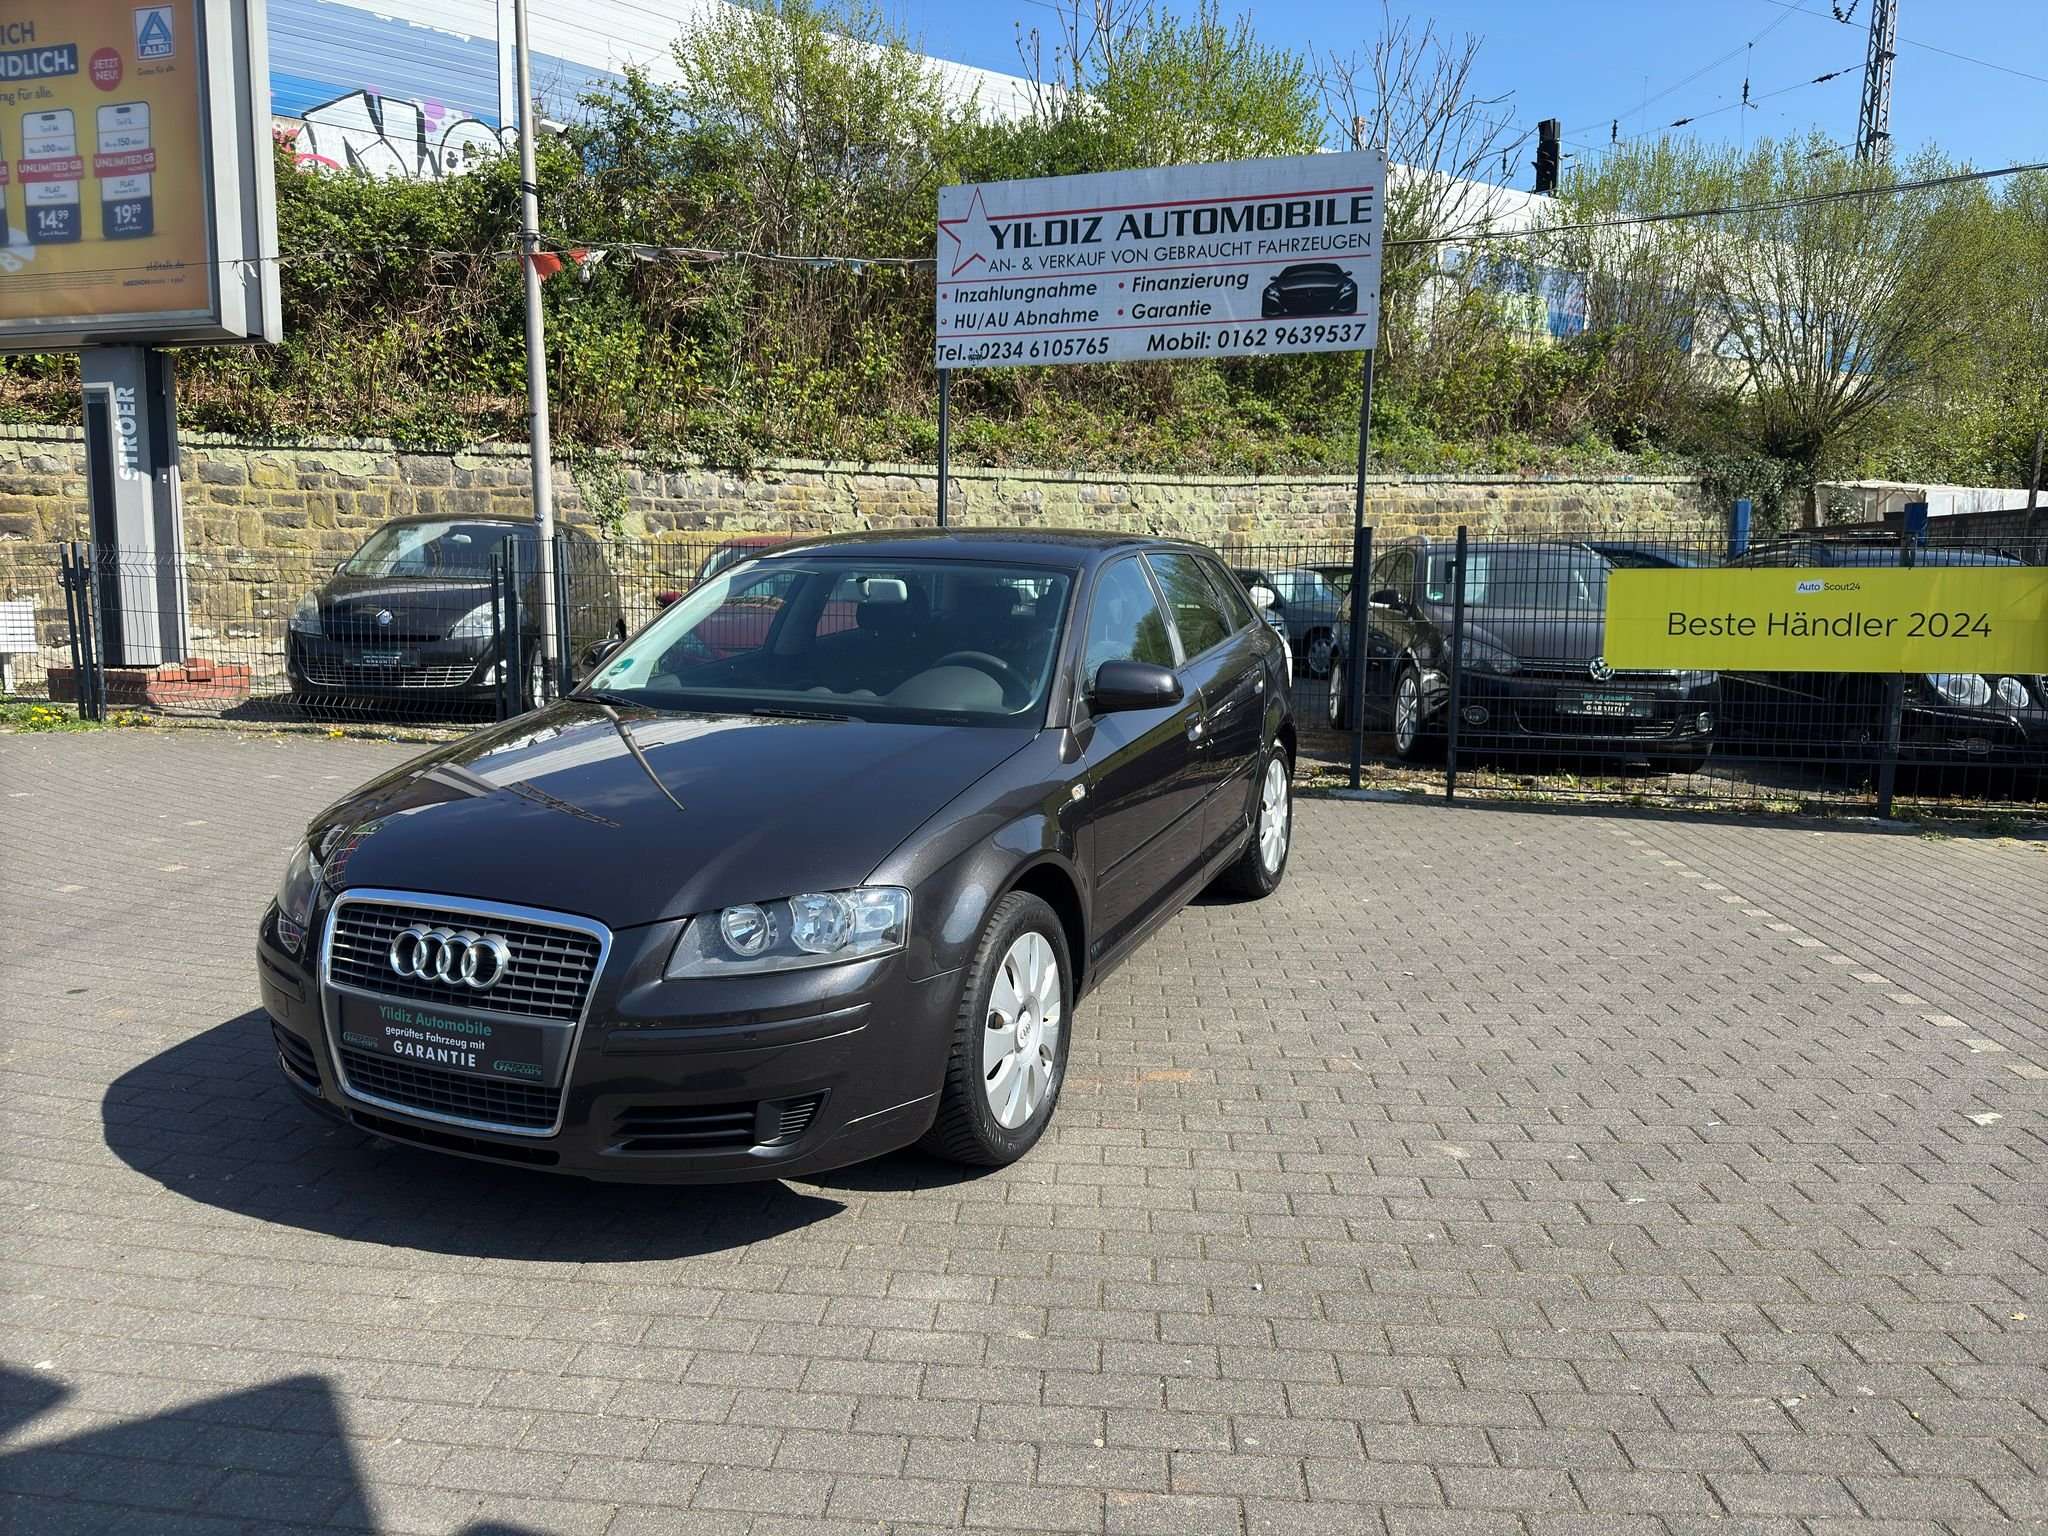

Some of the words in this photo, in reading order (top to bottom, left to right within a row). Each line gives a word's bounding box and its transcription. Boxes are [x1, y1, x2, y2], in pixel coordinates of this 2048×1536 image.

[988, 215, 1103, 250] YILDIZ
[1115, 195, 1374, 241] AUTOMOBILE
[988, 257, 1017, 273] AN-
[1021, 257, 1033, 271] &
[1038, 250, 1107, 269] VERKAUF
[1111, 247, 1149, 264] VON
[1153, 240, 1253, 262] GEBRAUCHT
[1257, 232, 1371, 255] FAHRZEUGEN
[954, 281, 1098, 304] Inzahlungnahme
[1131, 272, 1250, 293] Finanzierung
[954, 311, 1009, 331] HU/AU
[1013, 308, 1100, 327] Abnahme
[1131, 300, 1213, 320] Garantie
[980, 340, 1024, 361] 0234
[1029, 336, 1110, 359] 6105765
[1146, 331, 1211, 352] Mobil:
[1217, 327, 1268, 349] 0162
[1274, 323, 1367, 346] 9639537
[115, 386, 139, 481] STRÖER
[1798, 582, 1821, 592] Auto
[1823, 582, 1861, 592] Scout24
[1667, 612, 1757, 637] Beste
[1767, 611, 1898, 638] Händler
[1905, 612, 1993, 639] 2024
[378, 1005, 413, 1023] Yildiz
[415, 1013, 493, 1037] Automobile
[385, 1026, 424, 1040] geprüftes
[425, 1031, 467, 1049] Fahrzeug
[469, 1039, 485, 1050] mit
[393, 1039, 477, 1068] GARANTIE
